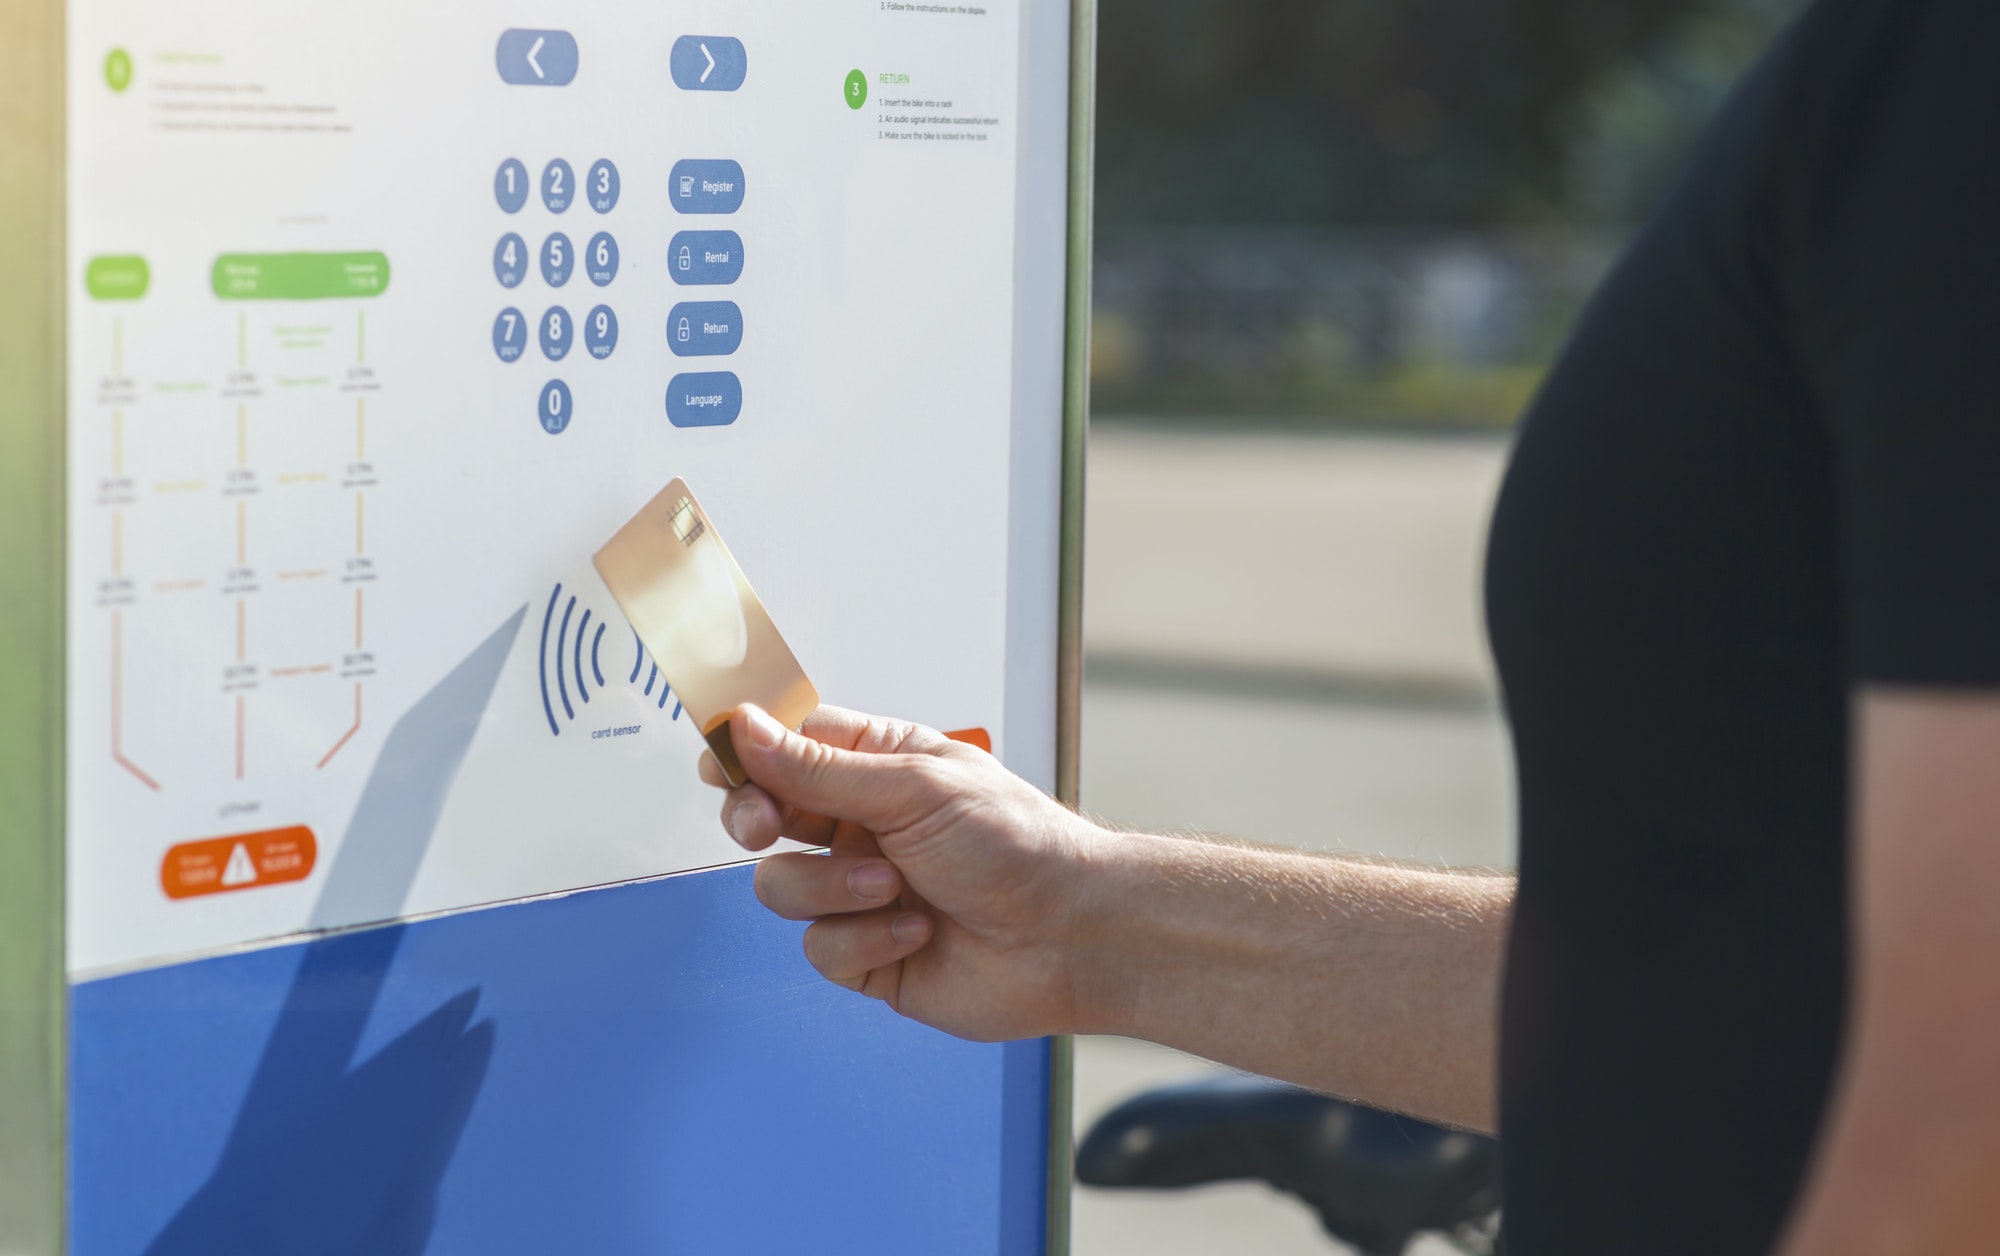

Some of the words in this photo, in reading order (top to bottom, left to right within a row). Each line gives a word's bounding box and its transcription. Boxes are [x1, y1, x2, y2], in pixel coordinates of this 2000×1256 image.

[887, 2, 905, 11] Follow
[906, 3, 915, 12] the
[916, 4, 948, 13] instructions
[957, 5, 966, 14] the
[968, 6, 986, 16] display
[879, 73, 910, 85] RETURN
[852, 82, 860, 96] 3
[885, 98, 900, 107] Insert
[902, 99, 911, 107] the
[912, 99, 923, 107] bike
[924, 99, 935, 108] into
[885, 115, 893, 123] An
[910, 116, 926, 126] signal
[928, 116, 952, 125] indicates
[885, 131, 899, 140] Make
[913, 132, 922, 140] the
[924, 132, 935, 140] bike
[942, 132, 959, 141] locked
[504, 166, 515, 194] 1
[550, 165, 564, 194] 2
[596, 166, 610, 194] 3
[702, 180, 734, 195] Register
[549, 198, 565, 209] abc
[596, 198, 610, 209] def
[502, 239, 518, 268] 4
[549, 239, 563, 268] 5
[595, 239, 609, 267] 6
[704, 250, 729, 264] Rental
[502, 314, 517, 342] 7
[548, 313, 562, 341] 8
[595, 311, 608, 339] 9
[703, 322, 729, 334] Return
[548, 388, 562, 416] 0
[685, 394, 723, 408] Language
[591, 727, 611, 739] card
[613, 725, 641, 736] sensor
